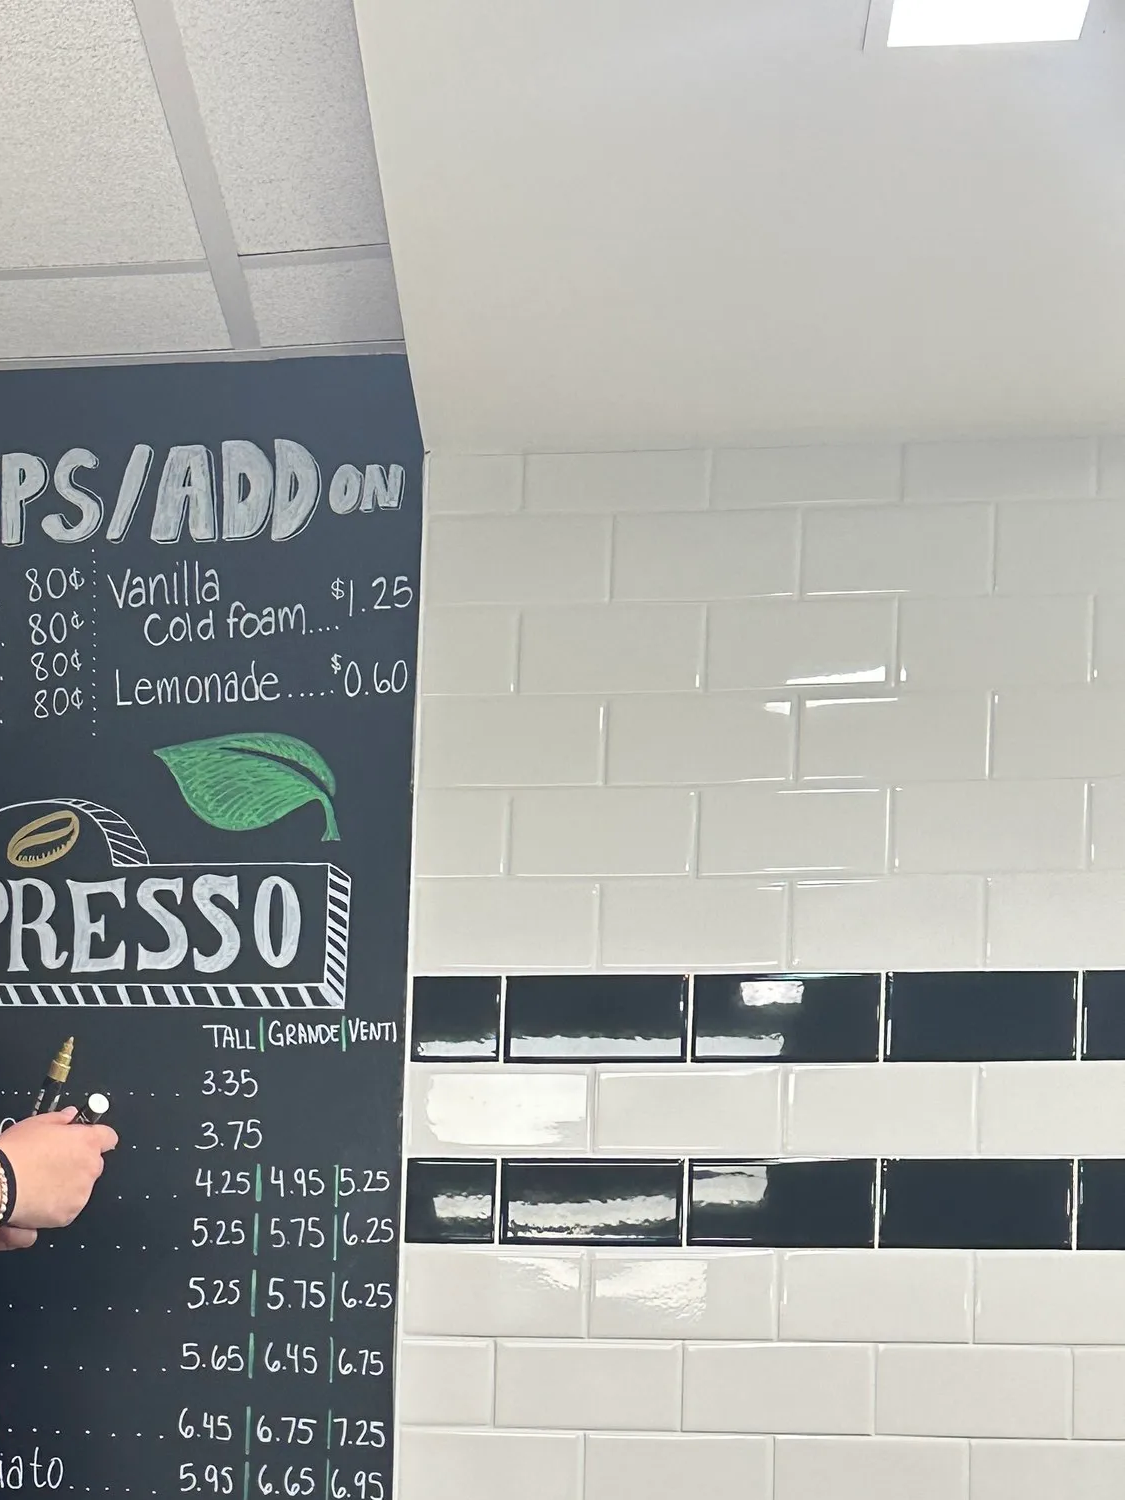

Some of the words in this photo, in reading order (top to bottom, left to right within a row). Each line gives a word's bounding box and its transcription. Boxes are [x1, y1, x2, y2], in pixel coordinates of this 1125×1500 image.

[329, 463, 405, 515] ON
[25, 567, 85, 602] 80¢
[107, 560, 220, 608] Vanilla
[28, 611, 85, 646] 80¢
[143, 609, 216, 646] Cold
[227, 600, 306, 639] foam
[30, 649, 83, 682] 80¢
[115, 660, 281, 705] Lemonade
[34, 687, 84, 719] 80¢
[202, 1024, 257, 1049] TALL
[268, 1020, 341, 1047] GRANDE
[348, 1017, 398, 1042] VENTI
[201, 1069, 259, 1098] 3.35
[194, 1118, 263, 1150] 3.75
[195, 1168, 251, 1197] 4.25
[270, 1166, 325, 1197] 4.95
[338, 1167, 390, 1196] 5.25
[191, 1217, 246, 1247] 5.25
[270, 1216, 325, 1248] 5.75
[342, 1212, 394, 1246] 6.25
[187, 1277, 241, 1309] 5.25
[266, 1277, 326, 1310] 5.75
[341, 1280, 393, 1309] 6.25
[180, 1342, 245, 1371] 5.65
[264, 1341, 318, 1375] 6.45
[337, 1347, 385, 1376] 6.75
[178, 1407, 232, 1441] 6.45
[256, 1414, 318, 1445] 6.75
[333, 1417, 386, 1448] 7.25
[179, 1462, 233, 1495] 5.95
[257, 1464, 315, 1496] 6.65
[330, 1468, 384, 1500] 6.95
